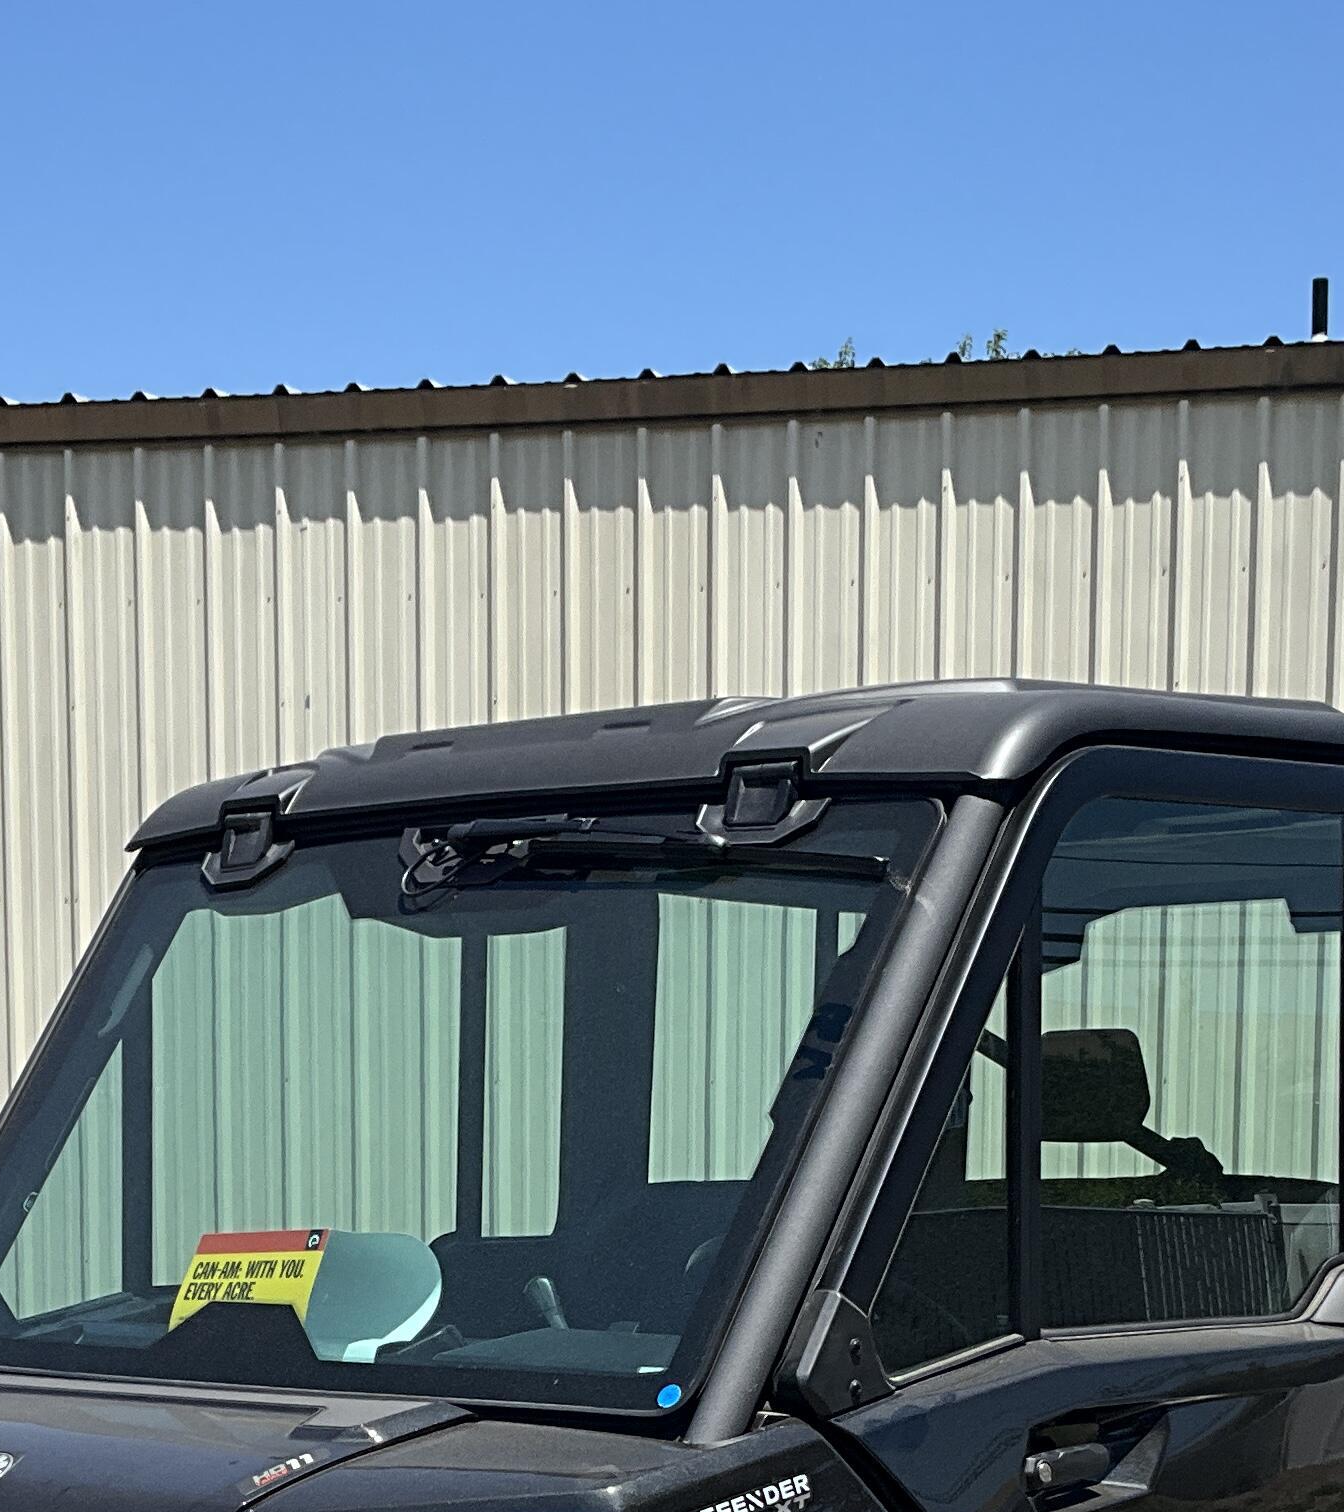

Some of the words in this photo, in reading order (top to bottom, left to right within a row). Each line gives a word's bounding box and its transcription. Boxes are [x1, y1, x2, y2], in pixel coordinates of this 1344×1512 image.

[245, 1260, 276, 1278] WITH
[279, 1259, 306, 1279] YOU.
[183, 1282, 221, 1300] EVERY
[222, 1281, 256, 1300] ACRE.
